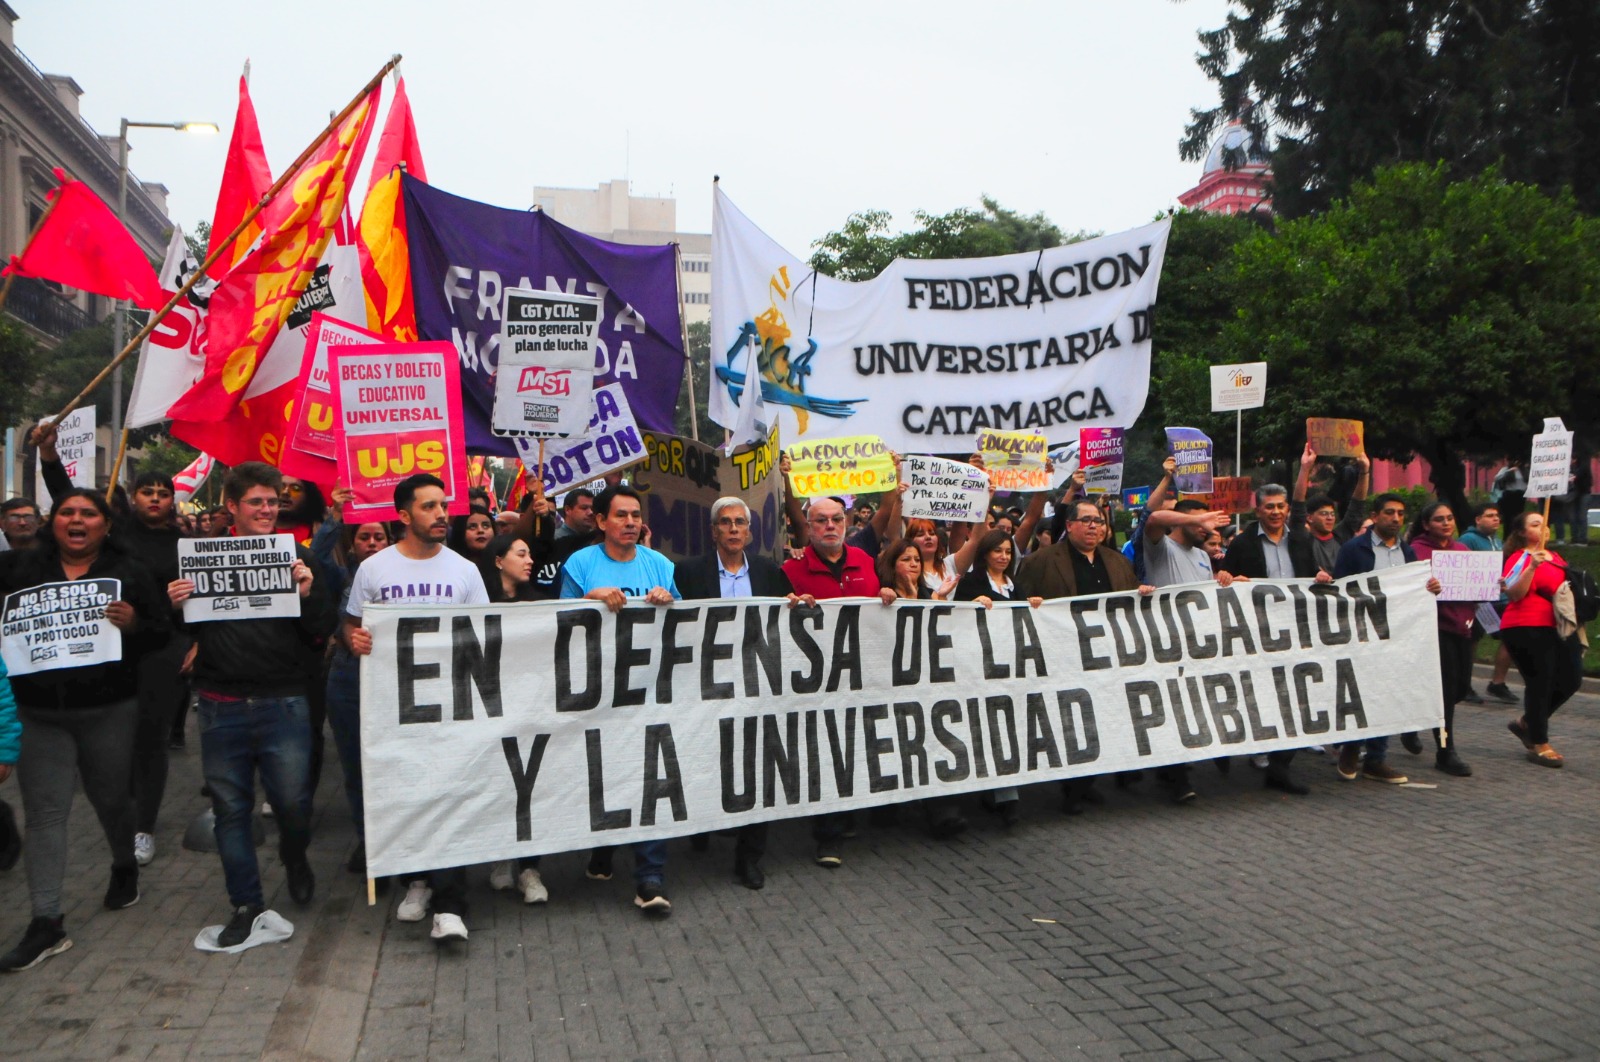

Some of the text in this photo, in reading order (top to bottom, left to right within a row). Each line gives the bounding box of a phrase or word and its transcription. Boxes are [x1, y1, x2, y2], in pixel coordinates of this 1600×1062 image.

[904, 244, 1152, 312] FEDERACION
[520, 304, 580, 320] CGT y CTA:
[507, 321, 593, 338] paro general y
[515, 339, 589, 354] plan de lucha
[853, 322, 1121, 376] UNIVERSITARIA
[341, 363, 382, 381] BECAS
[384, 362, 395, 380] Y
[395, 361, 442, 379] BOLETO
[522, 370, 570, 394] MST
[359, 384, 426, 403] EDUCATIVO
[346, 407, 444, 425] UNIVERSAL
[524, 409, 559, 419] IZQUIERDA
[525, 402, 550, 413] FRENTE
[901, 386, 1115, 436] CATAMARCA
[977, 433, 1044, 453] EDUCACIÓN
[1087, 437, 1122, 450] DOCENTE
[356, 440, 446, 479] UJS
[531, 424, 642, 492] BOTÓN
[789, 446, 812, 462] LA
[1086, 447, 1123, 460] LUCHANDO
[816, 460, 857, 472] ES UN
[909, 458, 926, 471] POR
[946, 462, 963, 474] POR
[793, 469, 877, 495] DERECHO
[911, 474, 928, 486] POR
[912, 489, 918, 500] Y
[952, 492, 967, 501] QUE
[194, 538, 277, 553] UNIVERSIDAD Y
[181, 552, 294, 568] CONICET DEL PUEBLO:
[184, 567, 292, 594] NO SE TOCAN
[19, 583, 99, 607] NO ES SOLO
[214, 598, 240, 610] MST
[3, 621, 31, 636] CHAU
[60, 612, 80, 625] LEY
[24, 623, 99, 646] Y PROTOCOLO
[32, 645, 58, 660] MST
[396, 613, 504, 725] EN
[553, 604, 863, 713] DEFENSA
[891, 605, 956, 687] DE
[975, 605, 1049, 680] LA
[501, 658, 1369, 842] Y LA UNIVERSIDAD PÚBLICA
